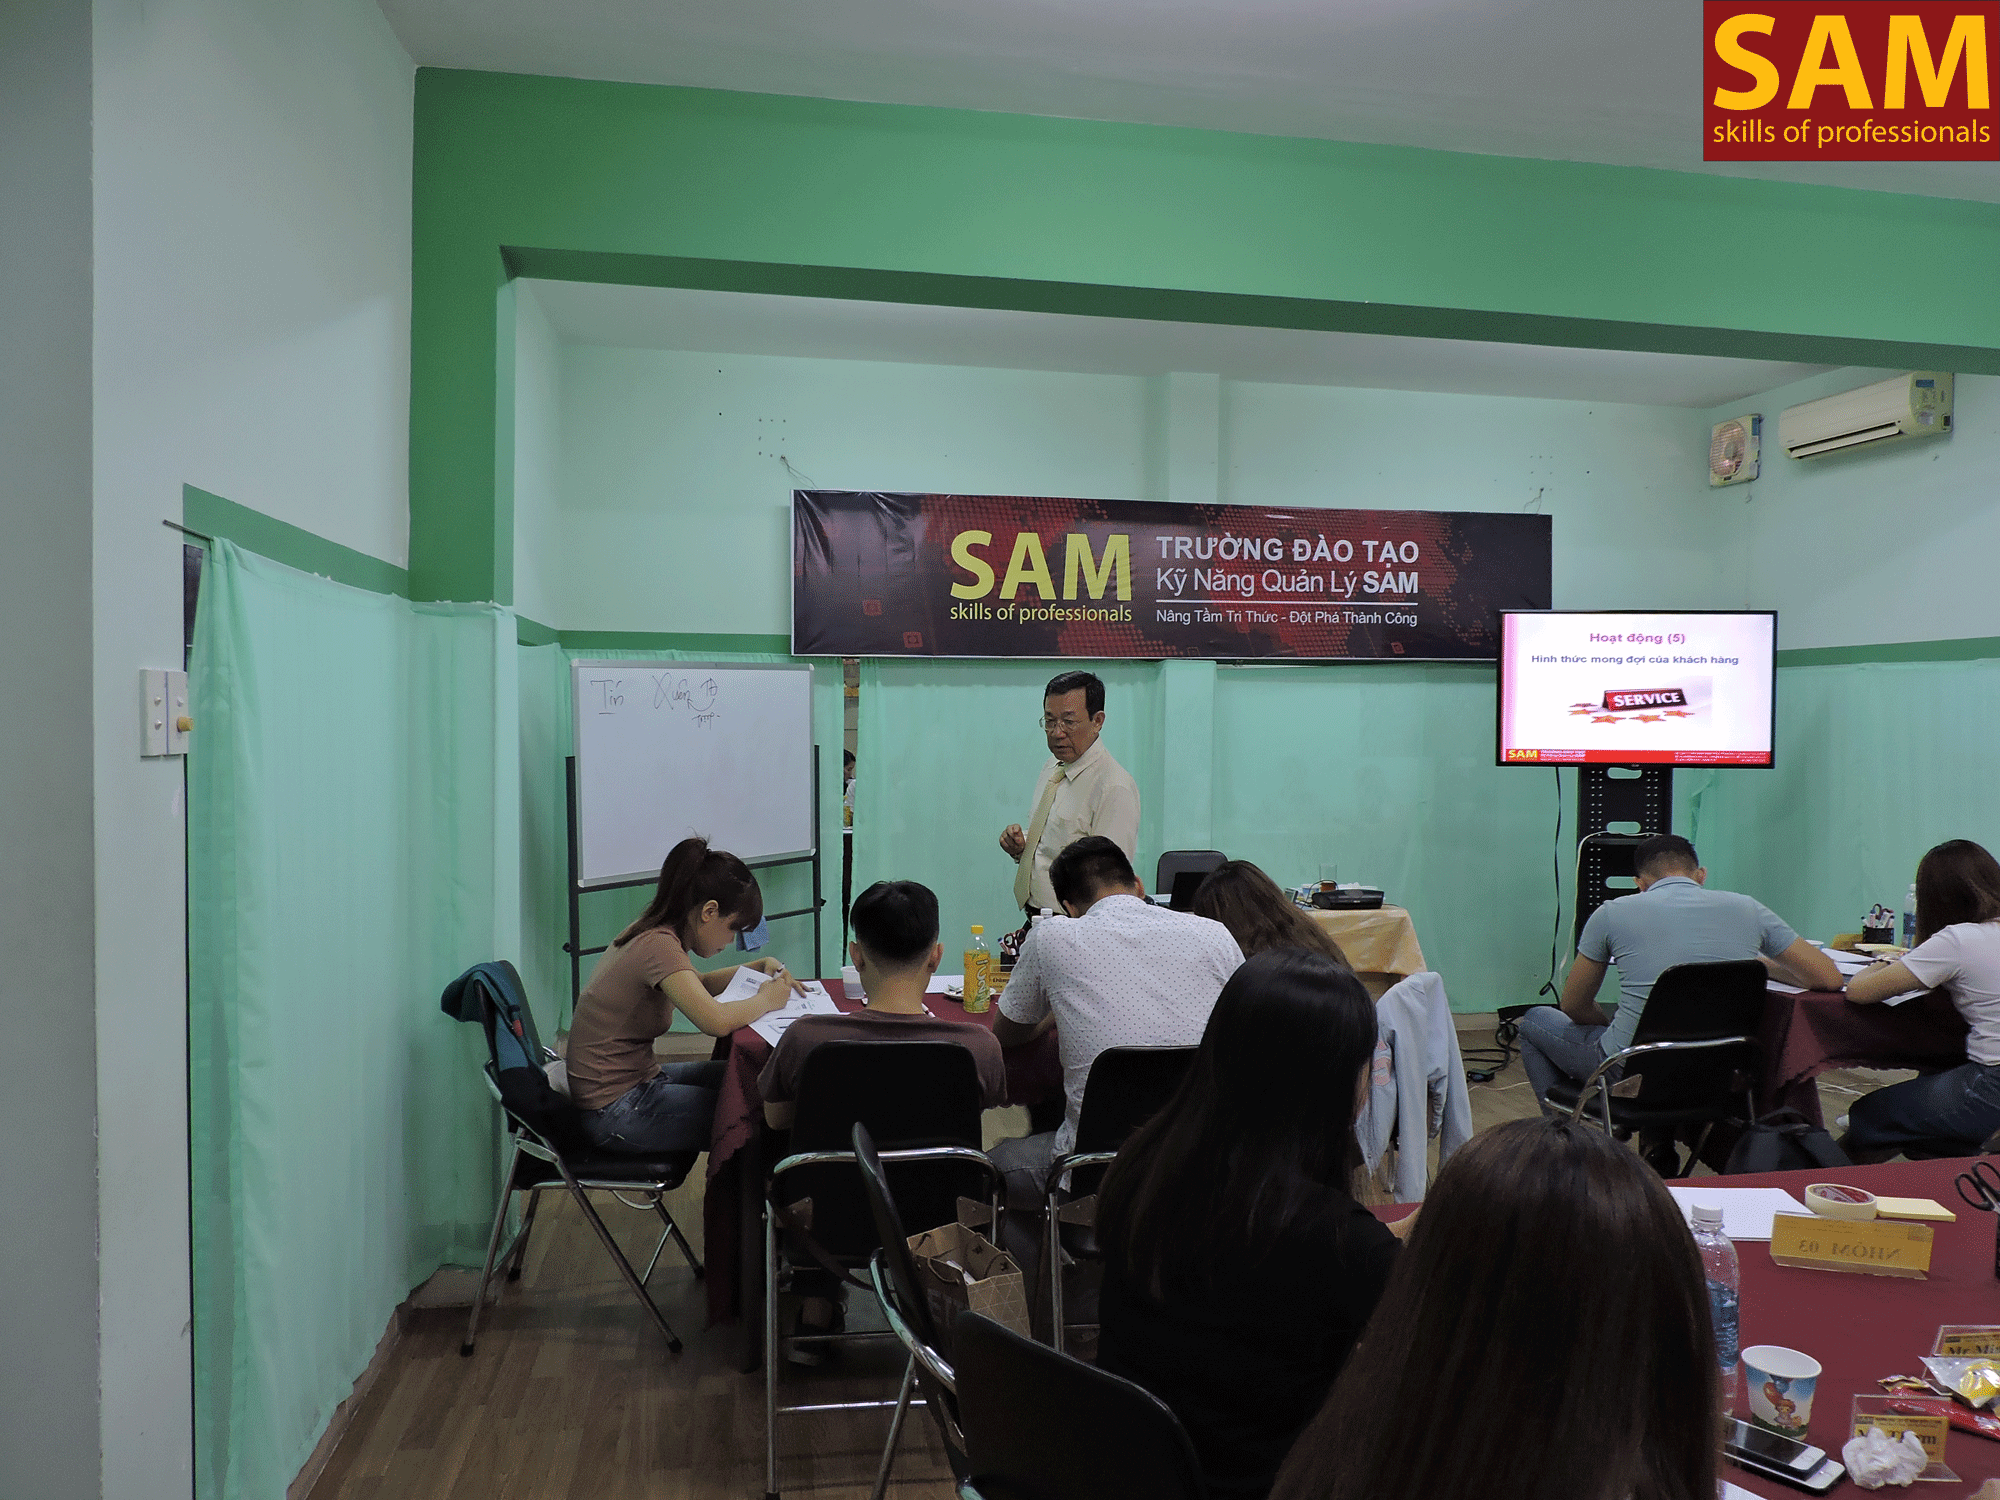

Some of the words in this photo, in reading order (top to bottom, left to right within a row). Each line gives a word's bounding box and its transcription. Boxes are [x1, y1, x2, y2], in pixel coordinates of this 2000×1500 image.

[1156, 532, 1283, 561] TRƯỜNG
[1292, 534, 1354, 562] ĐÀO
[1362, 540, 1419, 568] TẠO
[950, 530, 1132, 601] SAM
[1157, 568, 1187, 597] Kỹ
[1194, 568, 1254, 597] Năng
[1261, 569, 1324, 593] Quản
[1331, 570, 1357, 598] Lý
[1363, 571, 1419, 593] SAM
[950, 603, 992, 620] skills
[996, 603, 1015, 621] of
[1019, 604, 1132, 624] professionals
[1156, 609, 1191, 625] Nâng
[1194, 607, 1223, 622] Tầm
[1245, 610, 1279, 623] Thức
[1289, 610, 1312, 625] Đột
[1315, 611, 1340, 623] Phá
[1342, 611, 1382, 624] Thành
[1385, 611, 1418, 627] Công
[1589, 633, 1623, 644] Hoạt
[1626, 633, 1663, 645] động
[1667, 633, 1685, 645] (5)
[1560, 655, 1587, 663] thức
[1591, 657, 1623, 665] mong
[1673, 656, 1707, 664] khách
[1613, 692, 1681, 707] SERVICE
[1508, 749, 1538, 758] SAM
